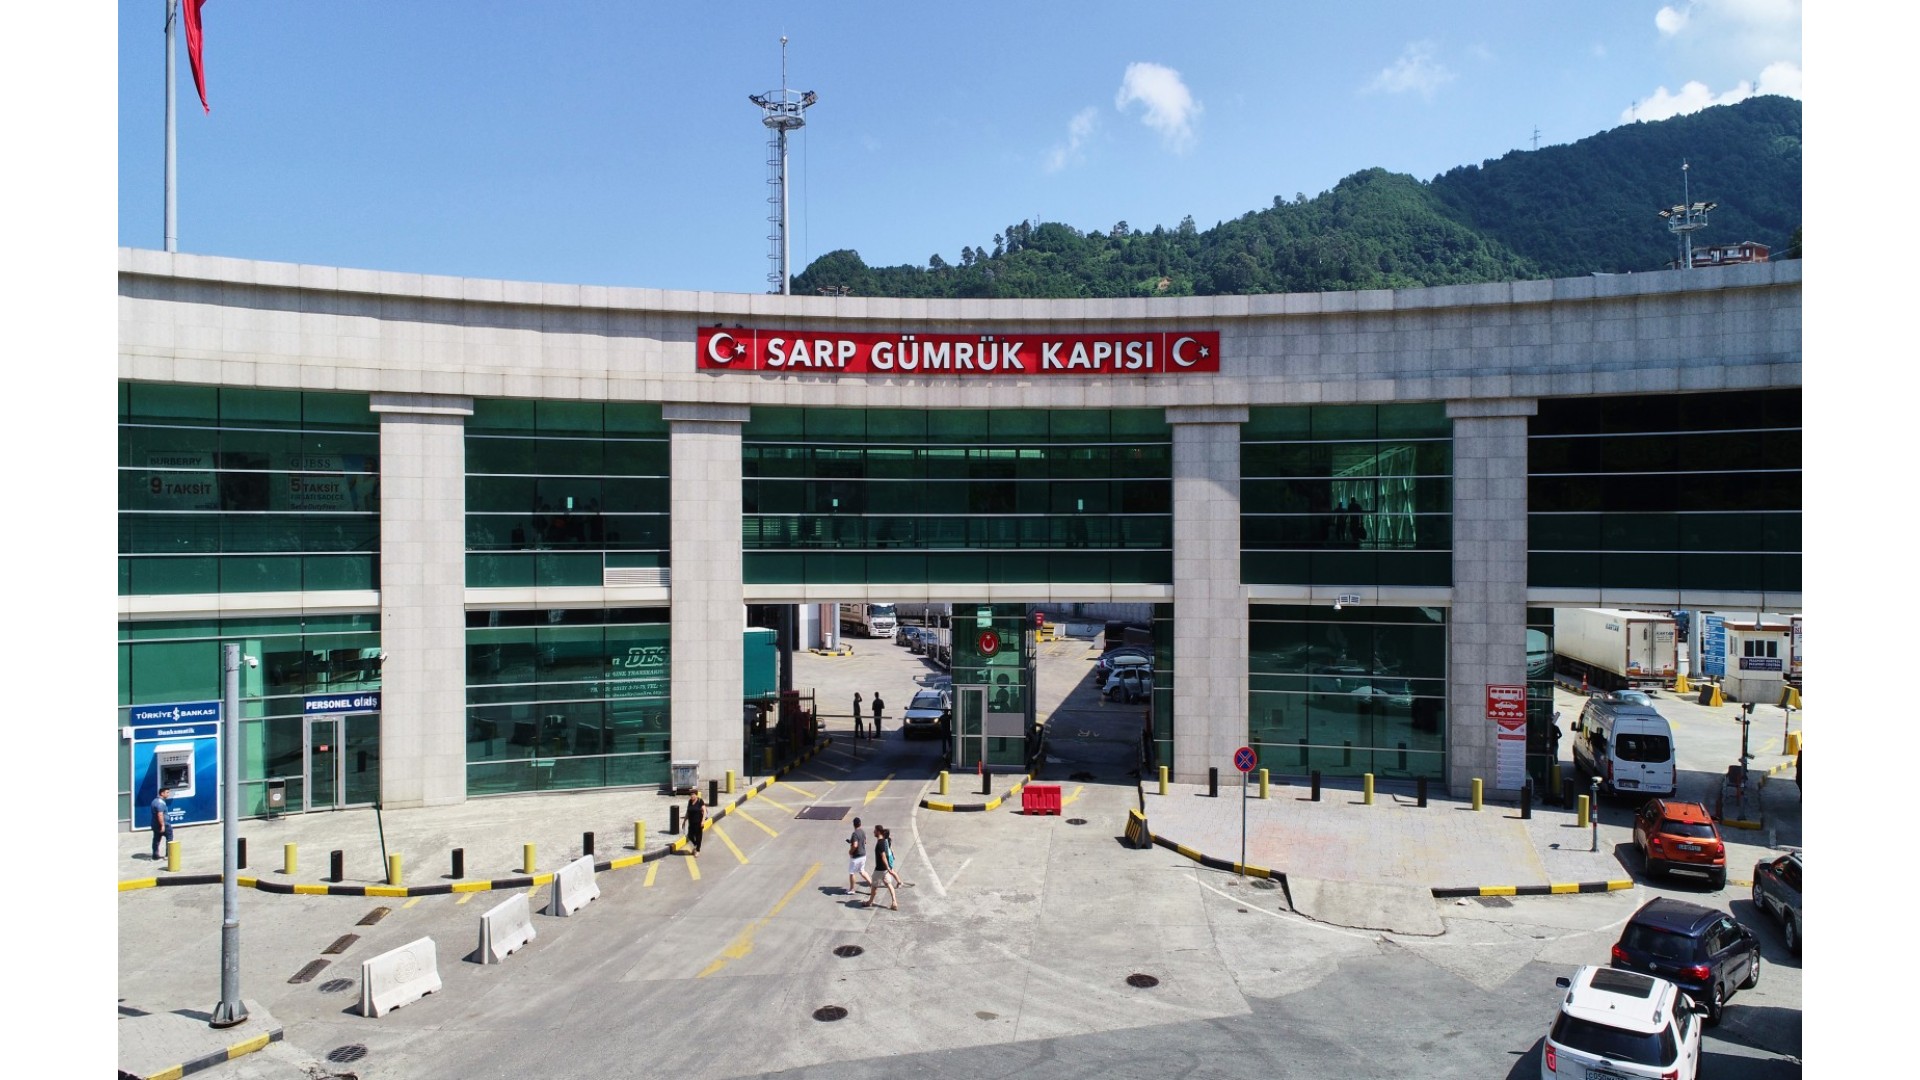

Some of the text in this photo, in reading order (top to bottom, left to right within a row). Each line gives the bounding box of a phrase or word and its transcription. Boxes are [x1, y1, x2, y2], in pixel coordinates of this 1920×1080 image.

[767, 335, 1154, 371] SARP GÜMRÜK KAPISI
[151, 457, 202, 466] BURBERRY
[151, 476, 212, 495] 9 TAKSİT
[291, 477, 340, 493] 5 TAKSİT
[306, 696, 377, 710] PERSONEL GİRİŞ
[136, 711, 172, 719] TÜRKİYE
[181, 709, 216, 717] BANKASI
